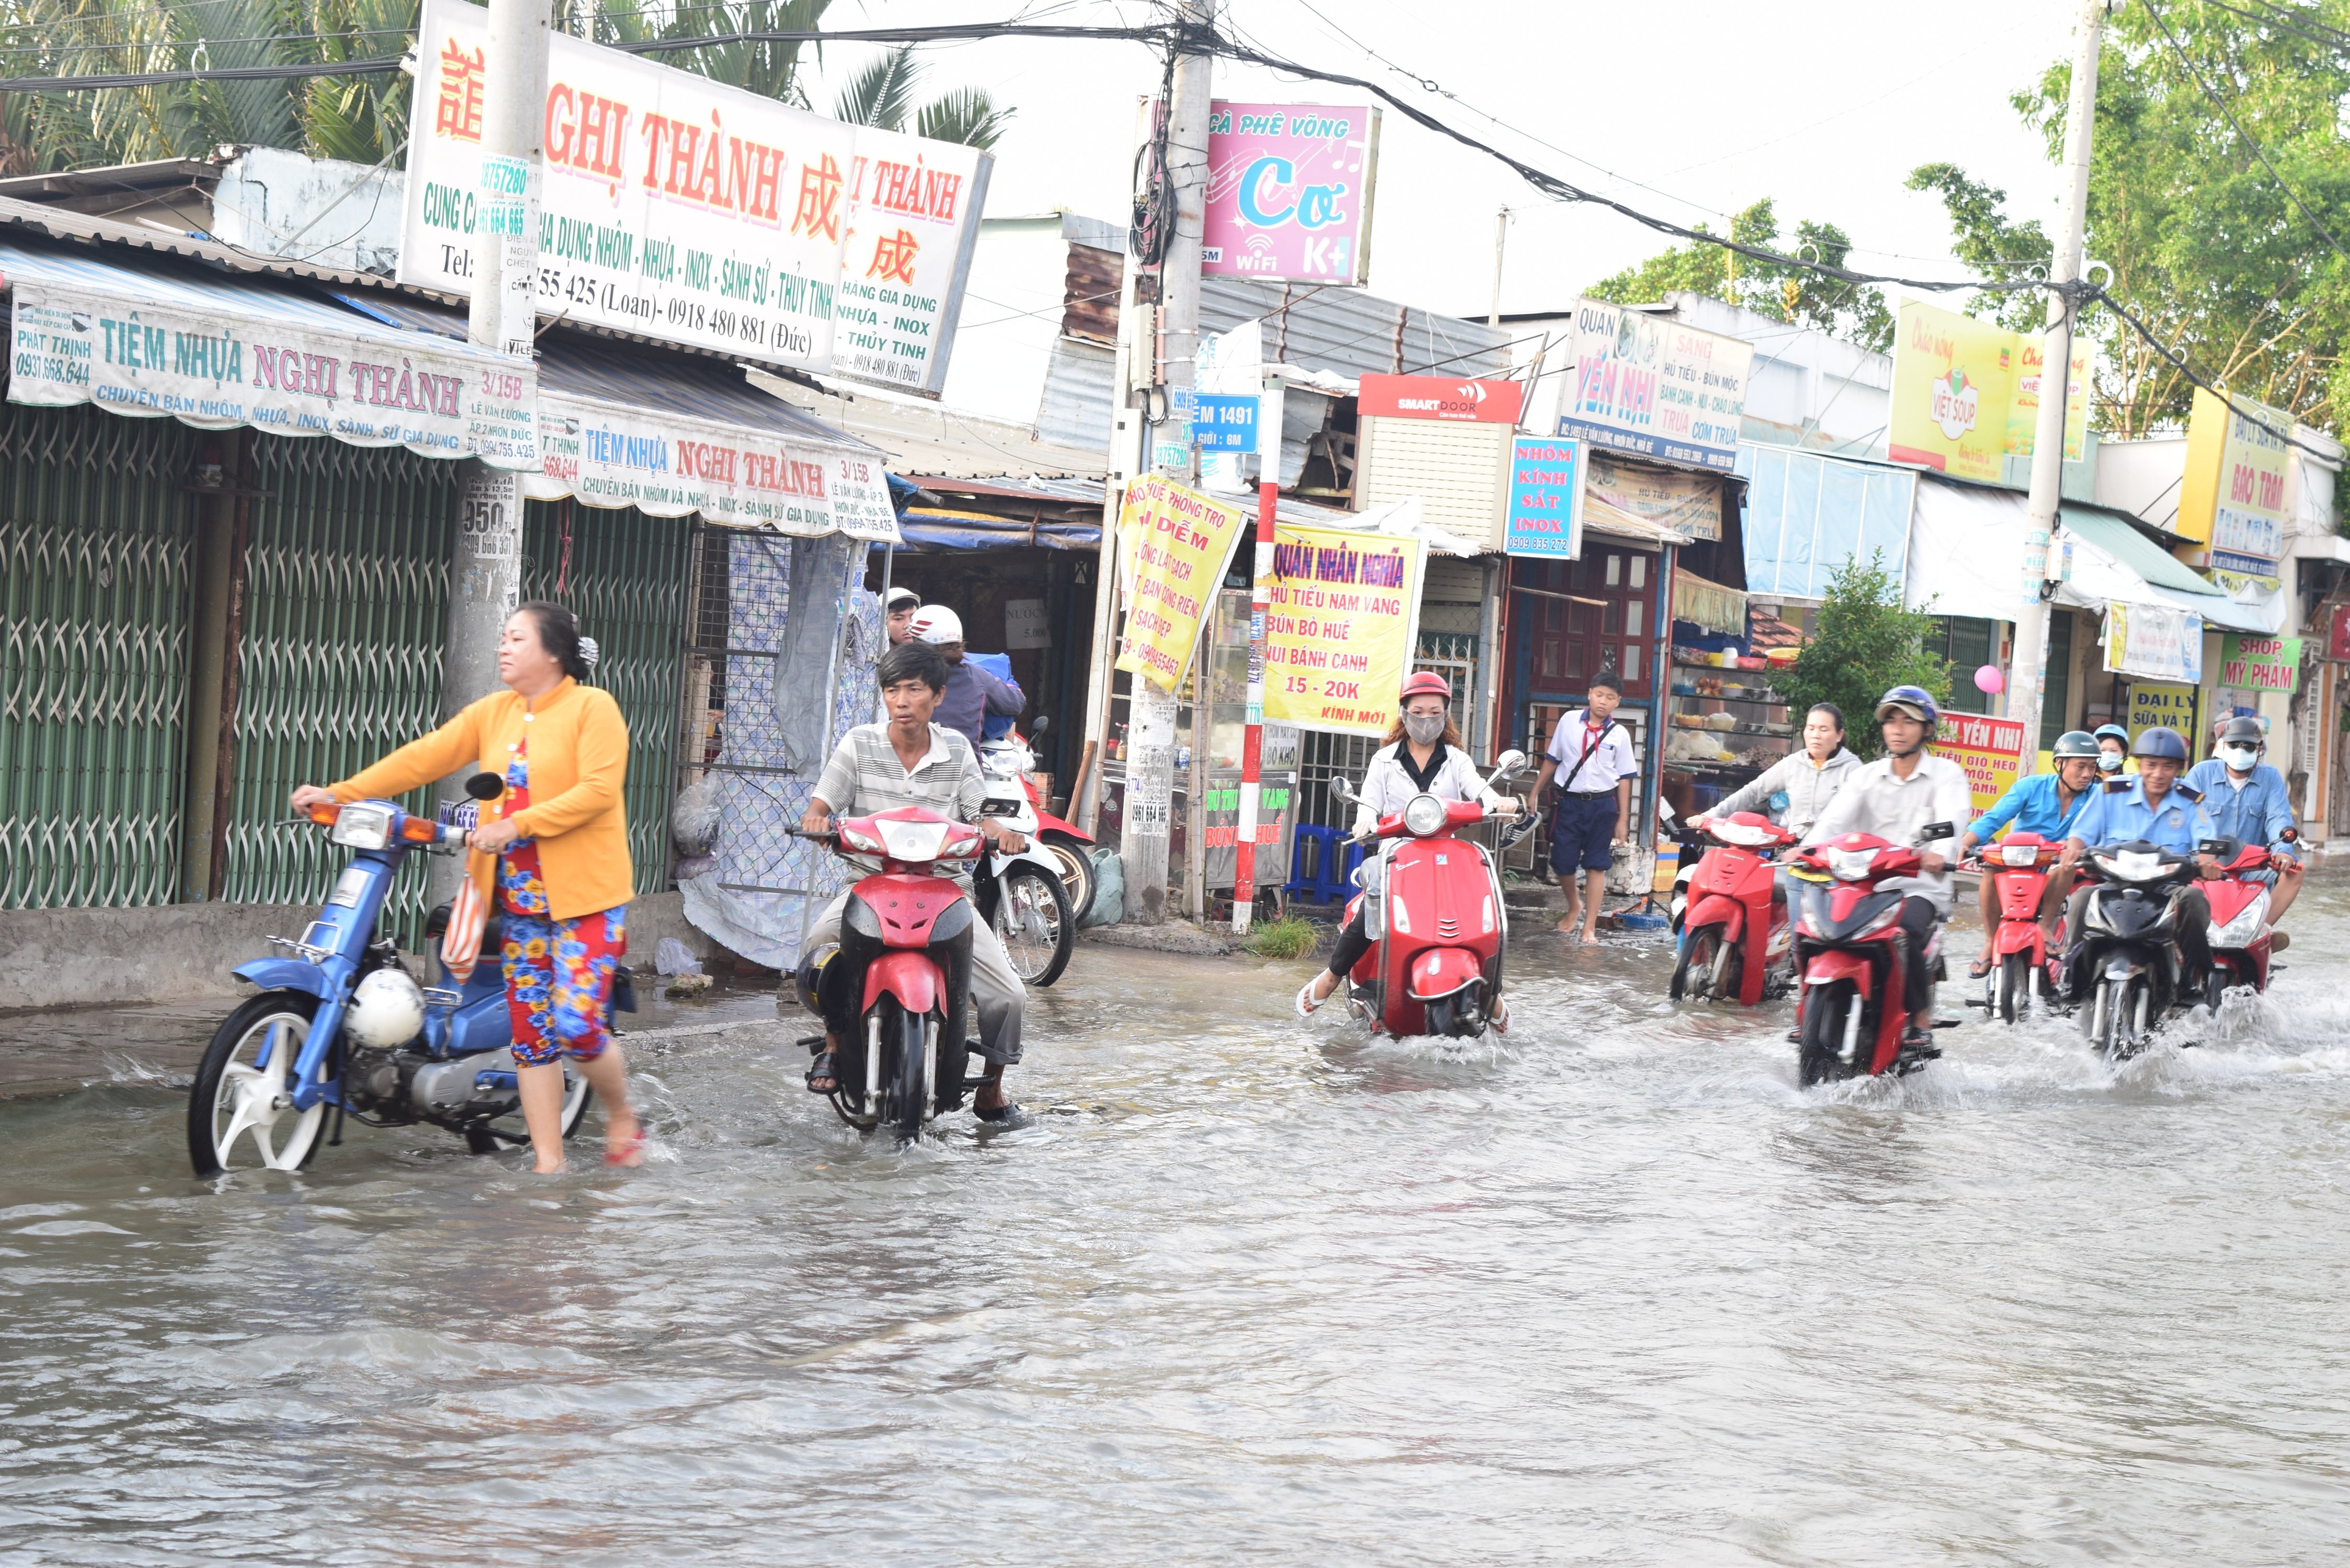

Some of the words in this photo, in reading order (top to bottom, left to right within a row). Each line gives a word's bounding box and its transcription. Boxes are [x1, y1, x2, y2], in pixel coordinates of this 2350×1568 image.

[1208, 111, 1231, 134] CÀ
[1239, 111, 1285, 136] PHÊ
[1291, 113, 1350, 139] VÕNG
[641, 107, 785, 222] THÀNH
[791, 152, 843, 243] 成
[872, 153, 962, 221] THÀNH
[1238, 156, 1346, 229] Cơ
[424, 181, 460, 232] CUNG
[557, 216, 593, 268] DỤNG
[595, 220, 633, 272] NHÔM
[642, 236, 674, 289] NHỰA
[685, 249, 712, 292] INOX
[721, 249, 752, 301] SÀNH
[753, 258, 771, 306] SỨ
[778, 261, 808, 314] THỦY
[809, 280, 834, 320] TINH
[867, 228, 919, 285] 成
[842, 281, 875, 301] HÀNG
[879, 289, 898, 305] GIA
[903, 294, 937, 313] DỤNG
[566, 275, 596, 305] 425
[668, 298, 705, 330] 0918
[709, 308, 735, 338] 480
[740, 315, 765, 344] 881
[771, 322, 812, 360] (Đức)
[836, 305, 878, 329] NHỰA
[893, 316, 930, 337] INOX
[1580, 306, 1616, 337] QUÁN
[18, 328, 47, 351] PHÁT
[51, 336, 91, 360] THỊNH
[848, 331, 888, 351] THỦY
[892, 340, 926, 360] TINH
[16, 352, 89, 386] 0937.668.644
[99, 311, 165, 377] TIỆM
[175, 329, 242, 390] NHỰA
[253, 344, 339, 409] NGHỊ
[349, 358, 463, 417] THÀNH
[481, 370, 522, 401] 3/15B
[854, 353, 871, 372] 0918
[872, 358, 885, 375] 480
[885, 360, 899, 378] 881
[900, 364, 920, 386] (Đức)
[1664, 359, 1676, 376] HỦ
[1678, 364, 1697, 382] TIẾU
[1703, 371, 1720, 387] BÚN
[1721, 375, 1738, 393] MỘC
[1575, 344, 1618, 416] YẾN
[1618, 366, 1656, 426] NHI
[1660, 381, 1677, 402] BÁNH
[1677, 388, 1694, 407] CANH
[1712, 394, 1727, 414] CHÁO
[96, 385, 159, 408] CHUYÊN
[163, 393, 194, 413] BÁN
[381, 423, 399, 442] SỨ
[403, 430, 423, 444] GIA
[425, 434, 459, 451] DỤNG
[471, 402, 482, 415] LÊ
[1219, 406, 1252, 425] 1491
[1933, 390, 1952, 423] VIỆT
[1953, 399, 1975, 424] SOUP
[469, 422, 481, 434] ẤP
[481, 424, 487, 434] 2
[488, 426, 508, 438] NHƠN
[511, 426, 532, 441] ĐỨC
[1662, 409, 1689, 433] TRƯA
[1692, 421, 1712, 442] CƠM
[1714, 425, 1737, 446] TRƯA
[553, 437, 579, 457] THỊNH
[585, 423, 624, 468] TIỆM
[626, 434, 667, 477] NHỰA
[676, 440, 736, 491] NGHỊ
[743, 448, 825, 498] THÀNH
[840, 459, 869, 483] 3/15B
[1516, 444, 1572, 463] NHÔM
[832, 482, 838, 495] LÊ
[878, 492, 884, 502] 3
[1517, 468, 1567, 486] KÍNH
[583, 476, 620, 497] CHUYÊN
[621, 479, 640, 499] BÁN
[643, 483, 669, 503] NHÔM
[671, 486, 683, 505] VÀ
[687, 490, 710, 510] NHỰA
[719, 496, 736, 513] INOX
[746, 498, 771, 518] SÀNH
[775, 504, 784, 520] SỨ
[787, 509, 802, 523] GIA
[805, 511, 830, 527] DỤNG
[866, 504, 879, 517] NHÀ
[880, 504, 890, 517] BÈ
[1126, 487, 1146, 506] CHO
[1168, 492, 1202, 518] PHÒNG
[1205, 507, 1226, 531] TRỌ
[1522, 489, 1560, 509] SẮT
[1156, 520, 1209, 551] DIỄM
[1515, 518, 1562, 533] INOX
[1508, 536, 1529, 548] 0909
[1532, 538, 1549, 549] 835
[1551, 539, 1568, 551] 272
[1157, 548, 1171, 572] LÁT
[1171, 558, 1193, 581] GẠCH
[1273, 536, 1314, 583] QUÁN
[1315, 541, 1358, 584] NHÂN
[1360, 547, 1404, 589] NGHĨA
[1142, 578, 1162, 598] BAN
[1177, 594, 1199, 619] RIÊNG
[1271, 581, 1288, 604] HỦ
[1292, 585, 1324, 608] TIẾU
[1329, 593, 1359, 612] NAM
[1363, 597, 1400, 616] VANG
[1136, 609, 1158, 630] SẠCH
[1268, 613, 1295, 635] BÚN
[1298, 615, 1317, 637] BÒ
[1322, 619, 1353, 640] HUẾ
[1290, 645, 1327, 668] BÁNH
[1331, 653, 1368, 672] CANH
[2239, 638, 2283, 655] SHOP
[1285, 676, 1307, 694] 15
[1324, 680, 1360, 699] 20K
[2224, 656, 2247, 685] MỸ
[2251, 654, 2293, 689] PHẨM
[1321, 706, 1354, 721] KÍNH
[1358, 710, 1386, 725] MỜI
[2138, 693, 2168, 709] ĐẠI
[2133, 710, 2157, 725] SỮA
[2162, 712, 2178, 727] VÀ
[1962, 719, 1990, 747] YẾN
[1992, 727, 2021, 751] NHI
[1267, 741, 1277, 765] BÒ
[1279, 746, 1295, 765] KHO
[1966, 756, 1988, 768] GIÒ
[1992, 759, 2017, 771] HEO
[1132, 804, 1167, 823] 0961.664.665
[1262, 788, 1289, 810] VANG
[1206, 818, 1235, 848] BÚN
[1254, 813, 1284, 845] HUẾ
